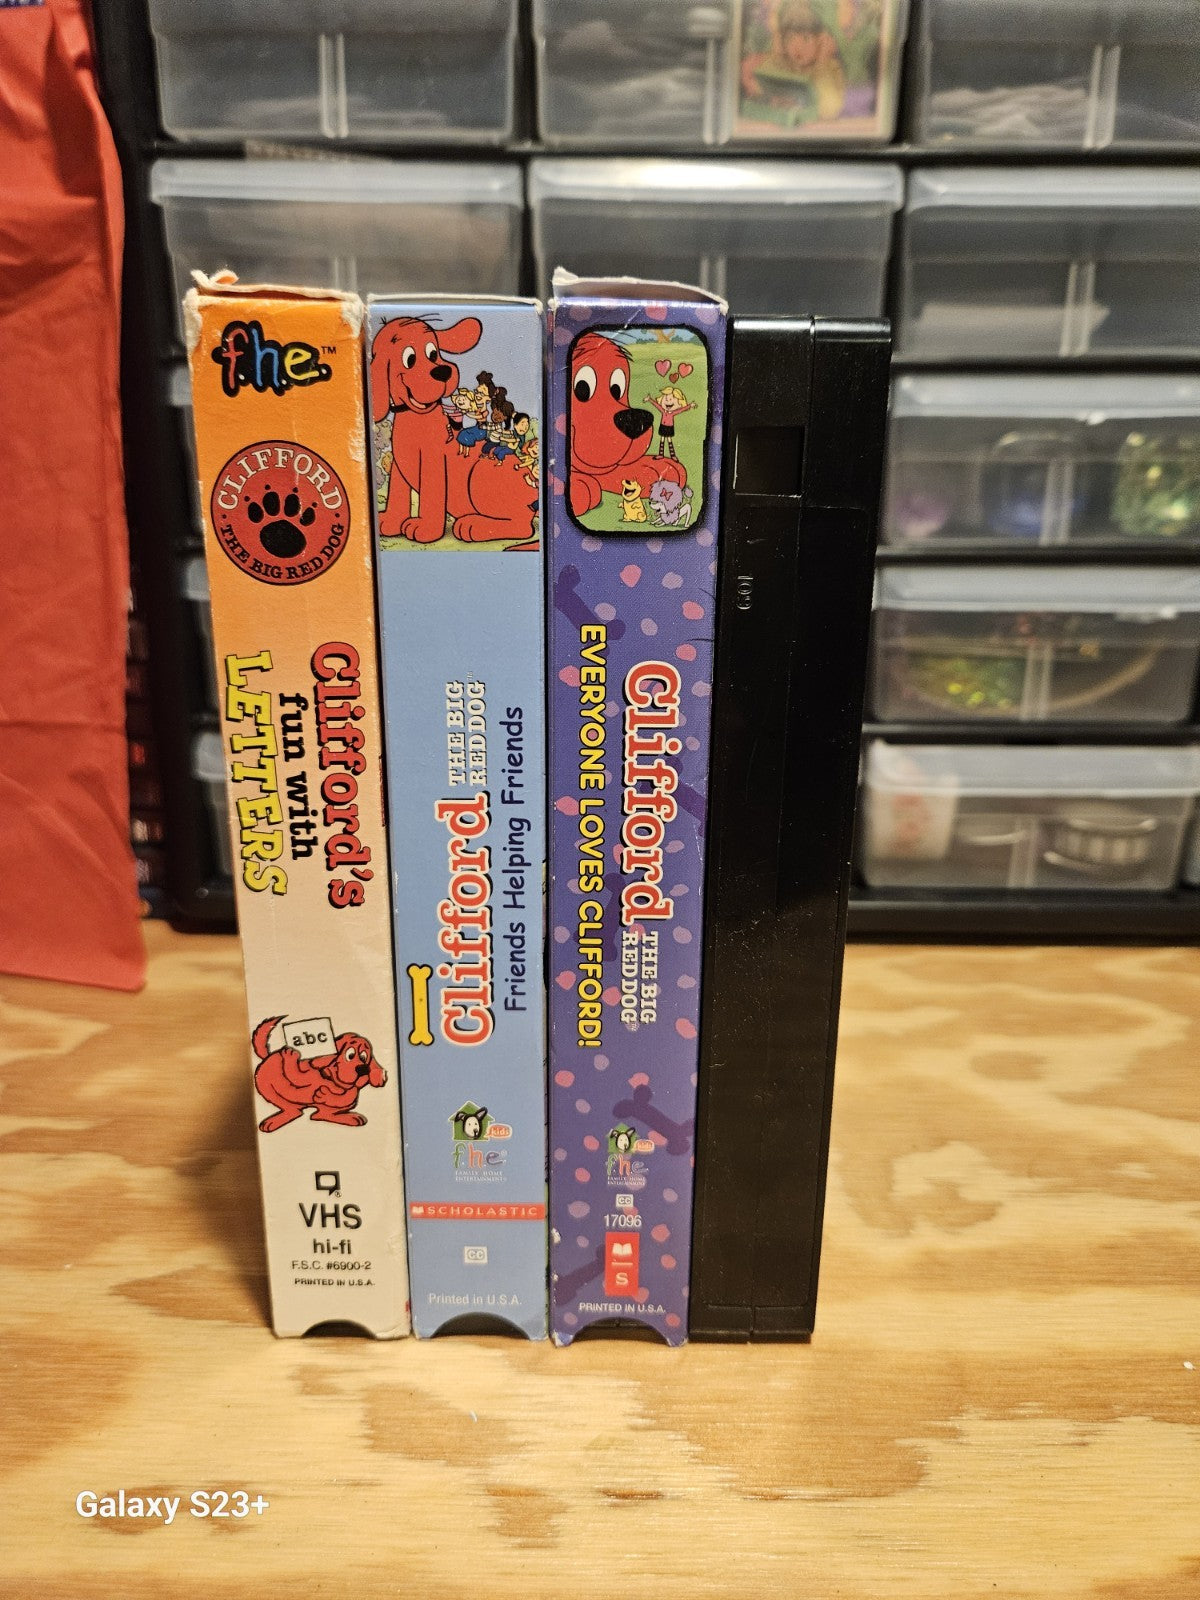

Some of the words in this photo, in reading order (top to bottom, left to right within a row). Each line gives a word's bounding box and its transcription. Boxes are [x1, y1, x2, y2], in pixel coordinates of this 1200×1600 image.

[217, 447, 343, 510] CLIFFORD
[220, 524, 250, 564] THE
[249, 559, 283, 579] BIG
[286, 558, 325, 580] RED
[322, 523, 345, 561] DOG
[279, 692, 309, 762] fun
[445, 680, 465, 729] BIG
[466, 680, 487, 733] DOG
[577, 623, 607, 791] EVERYONE
[225, 650, 289, 896] LETTERS
[311, 641, 374, 910] Clifford's
[448, 733, 467, 787] THE
[468, 733, 488, 787] RED
[499, 706, 524, 805] Friends
[286, 771, 318, 861] with
[621, 660, 683, 928] Clifford
[502, 816, 532, 909] Helping
[577, 798, 606, 893] LOVES
[434, 791, 495, 1047] Clifford
[503, 921, 527, 1012] Friends
[576, 899, 605, 1048] CLIFFORD!
[621, 930, 639, 978] RED
[640, 930, 659, 979] THE
[620, 979, 638, 1024] DOG
[639, 983, 658, 1024] BIG
[292, 1030, 328, 1048] abc
[490, 1126, 510, 1137] kids
[299, 1202, 363, 1229] VHS
[427, 1205, 537, 1217] SCHOLASTIC
[604, 1214, 642, 1228] 17096
[291, 1260, 324, 1270] F.S.C.
[326, 1260, 372, 1271] #6900-2
[313, 1238, 352, 1255] hi-fi
[294, 1277, 334, 1286] PRINTED
[336, 1278, 346, 1286] IN
[348, 1278, 376, 1287] U.S.A.
[429, 1292, 469, 1305] Printed
[473, 1293, 483, 1305] in
[487, 1294, 523, 1306] U.S.A.
[579, 1302, 623, 1313] PRINTED
[625, 1303, 636, 1313] IN
[638, 1303, 666, 1314] U.S.A.
